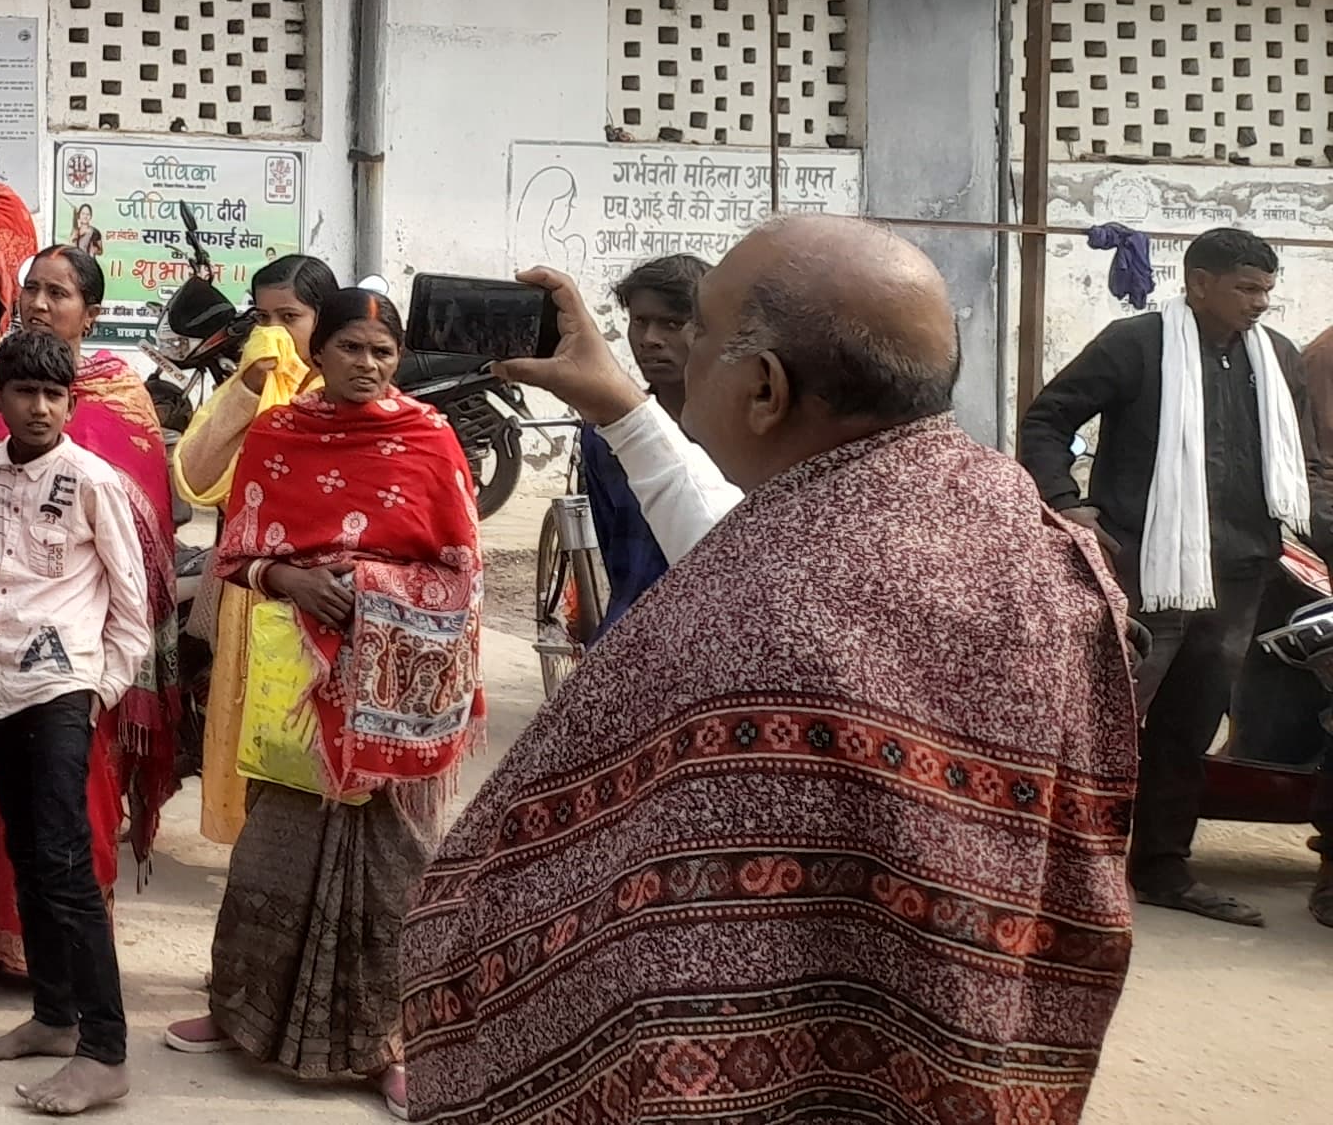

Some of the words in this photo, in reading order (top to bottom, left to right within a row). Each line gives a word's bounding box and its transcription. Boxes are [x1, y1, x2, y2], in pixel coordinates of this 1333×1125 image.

[143, 155, 217, 183] जीविका
[612, 154, 678, 185] गर्भवती
[683, 156, 741, 189] महिला
[795, 166, 837, 198] मुफ्त
[217, 197, 247, 222] दीदी
[238, 228, 263, 249] सेवा
[595, 222, 640, 255] अपनी
